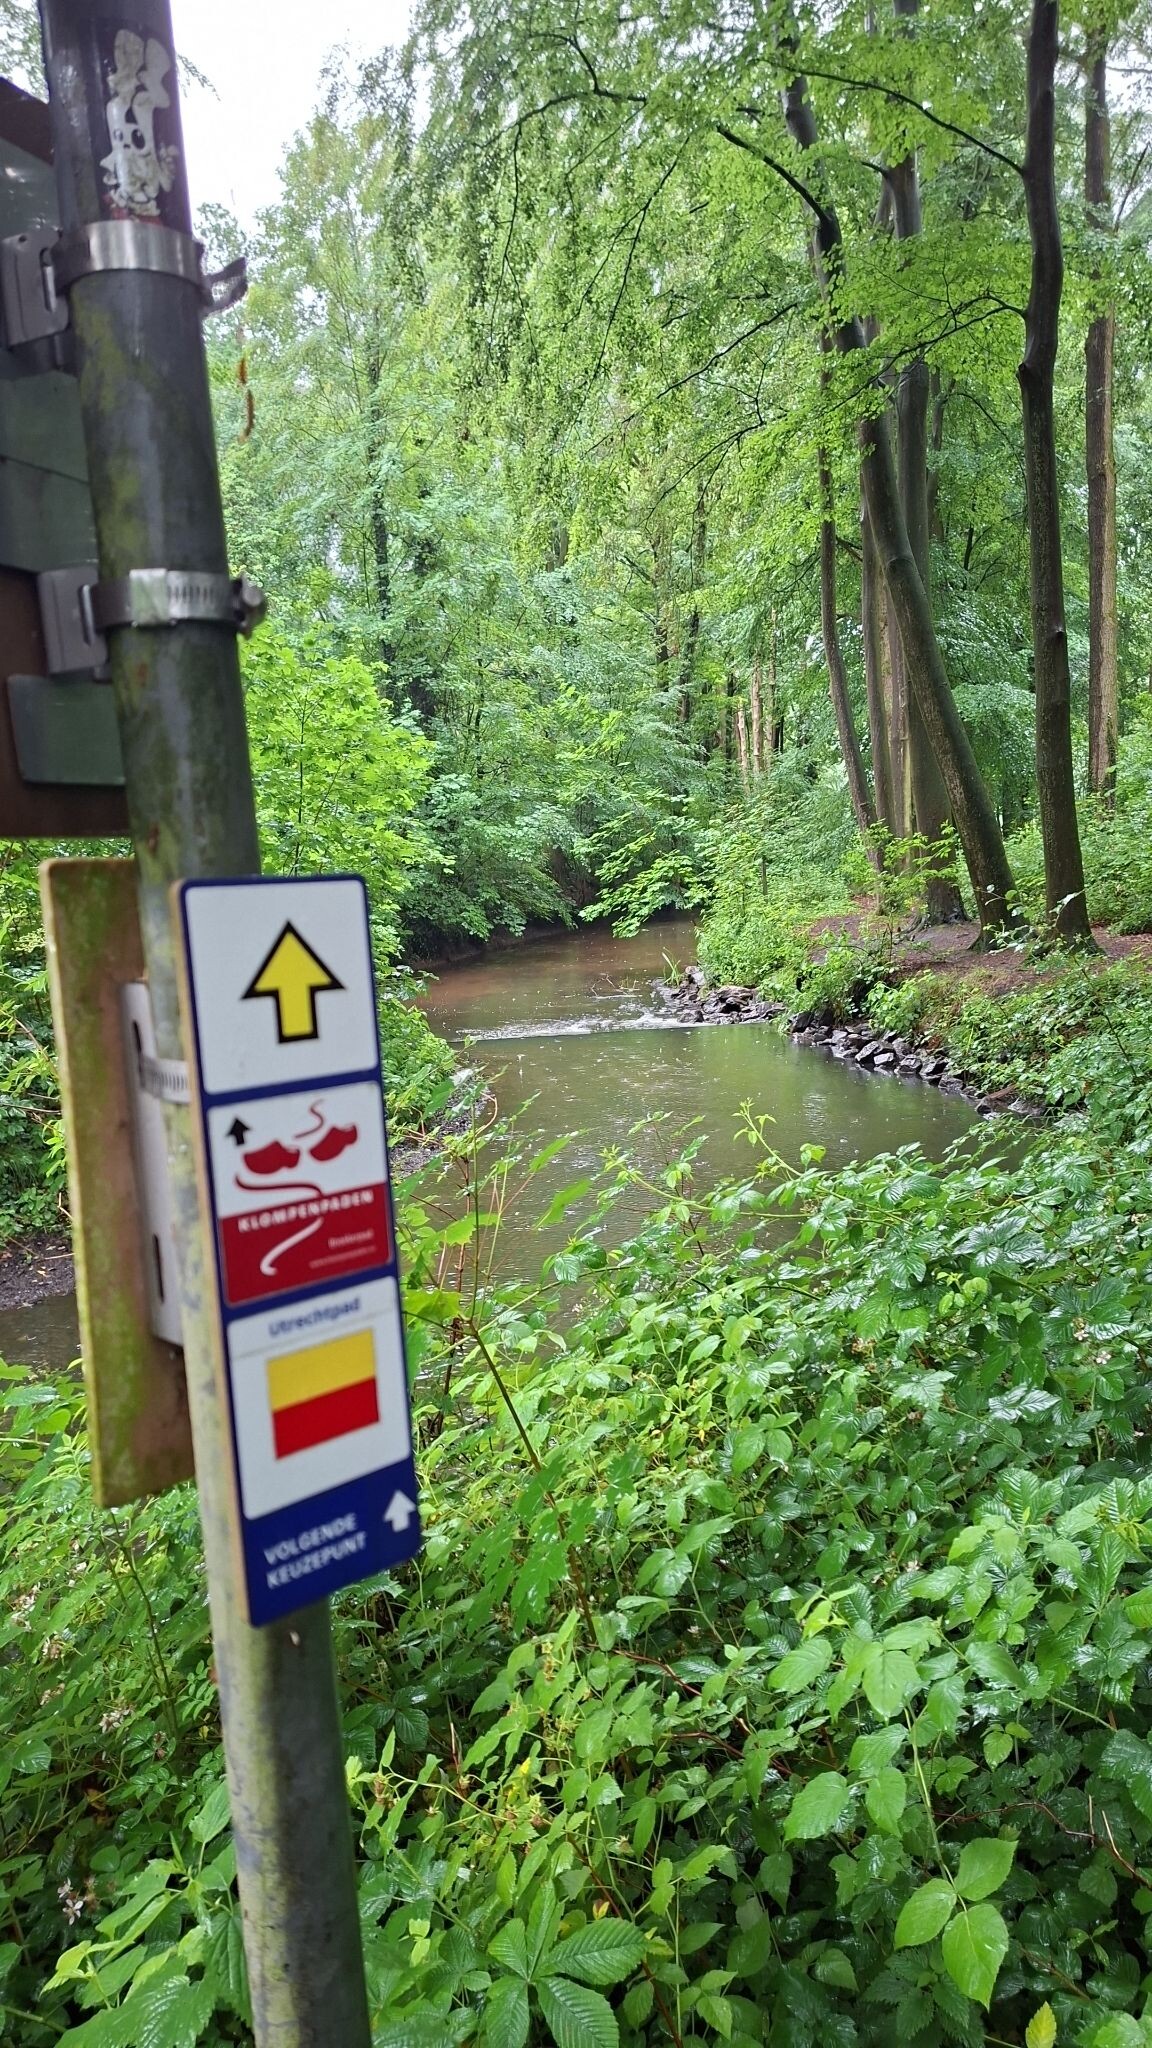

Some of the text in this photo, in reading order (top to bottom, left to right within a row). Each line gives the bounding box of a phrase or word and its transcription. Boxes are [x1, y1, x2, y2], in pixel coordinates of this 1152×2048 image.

[237, 1189, 374, 1233] KLOMPENPADEN
[268, 1297, 361, 1337] Utrechtpad
[263, 1513, 357, 1566] VOLGENDE
[266, 1531, 367, 1590] KEUZEPUNT
